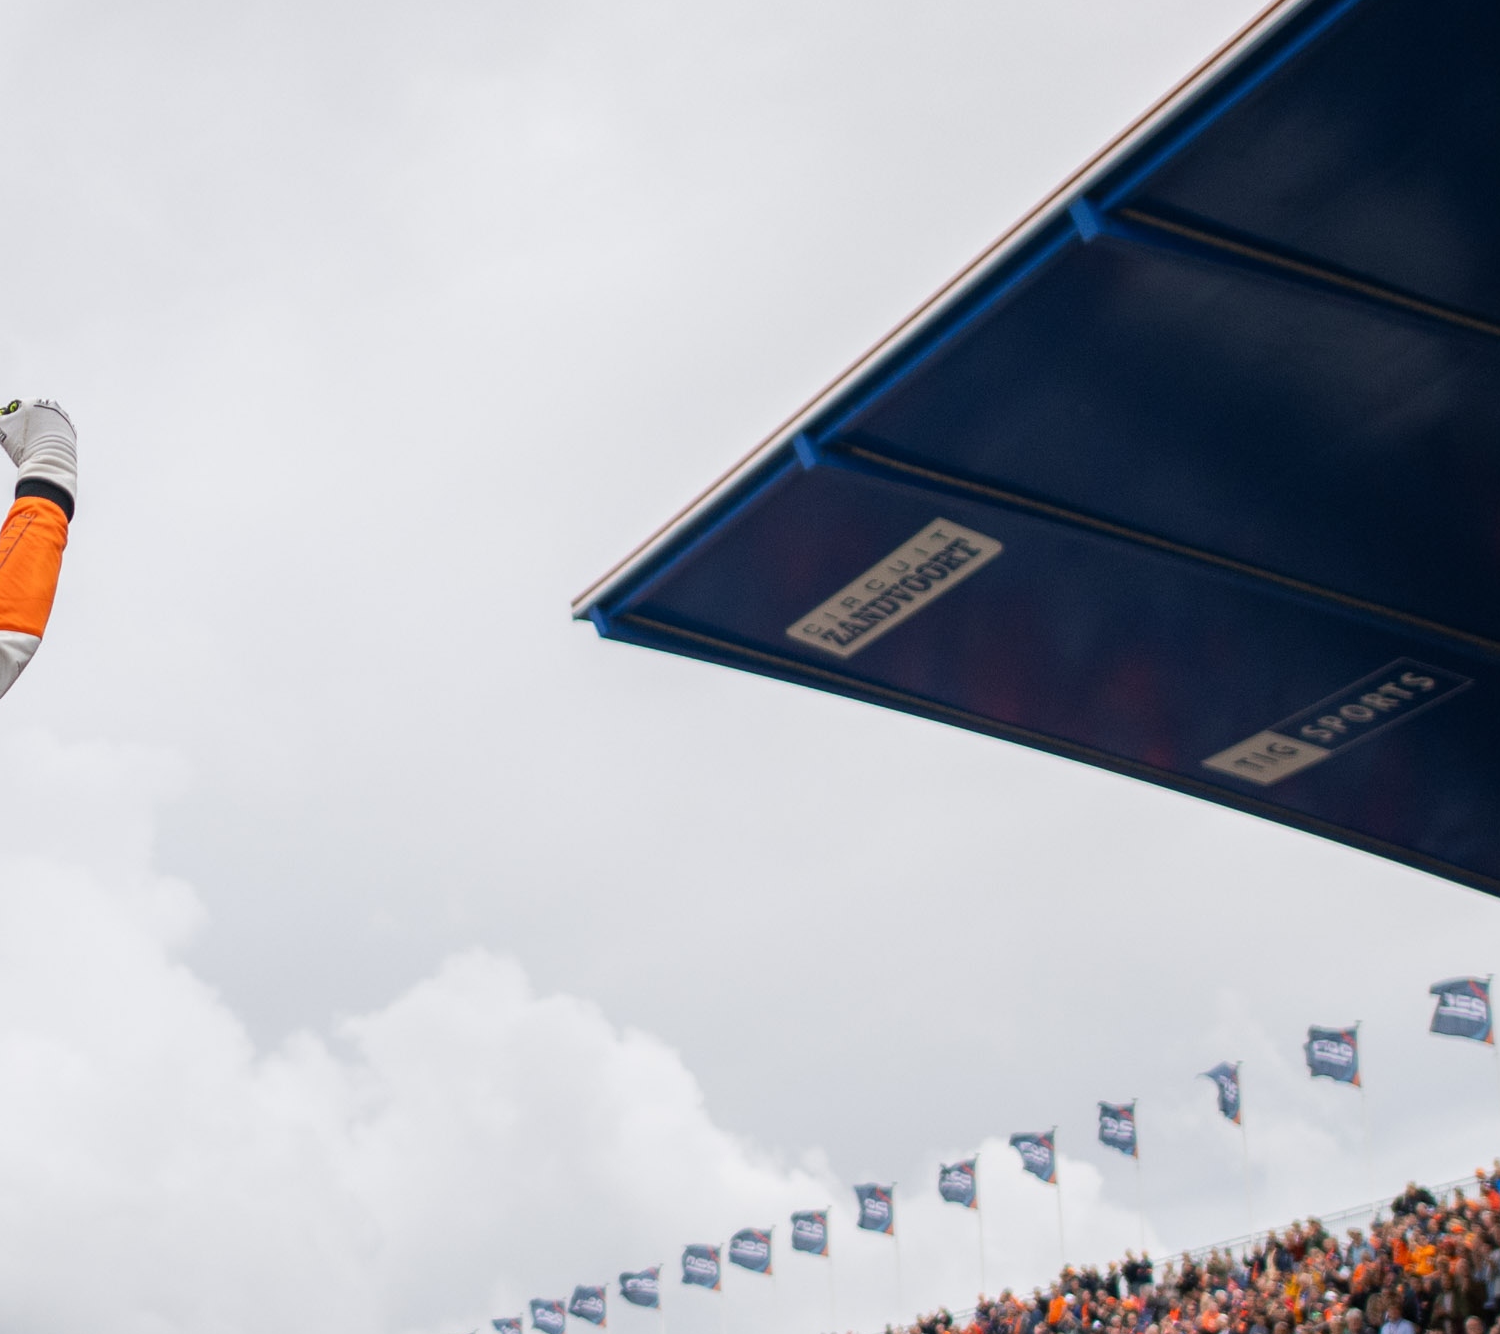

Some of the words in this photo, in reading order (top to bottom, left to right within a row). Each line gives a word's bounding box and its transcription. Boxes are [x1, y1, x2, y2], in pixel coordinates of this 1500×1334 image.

[803, 528, 950, 636] CIRCUIT
[820, 536, 982, 646] ZANDVOORT
[1233, 741, 1299, 771] TIG
[1301, 671, 1436, 742] SPORTS
